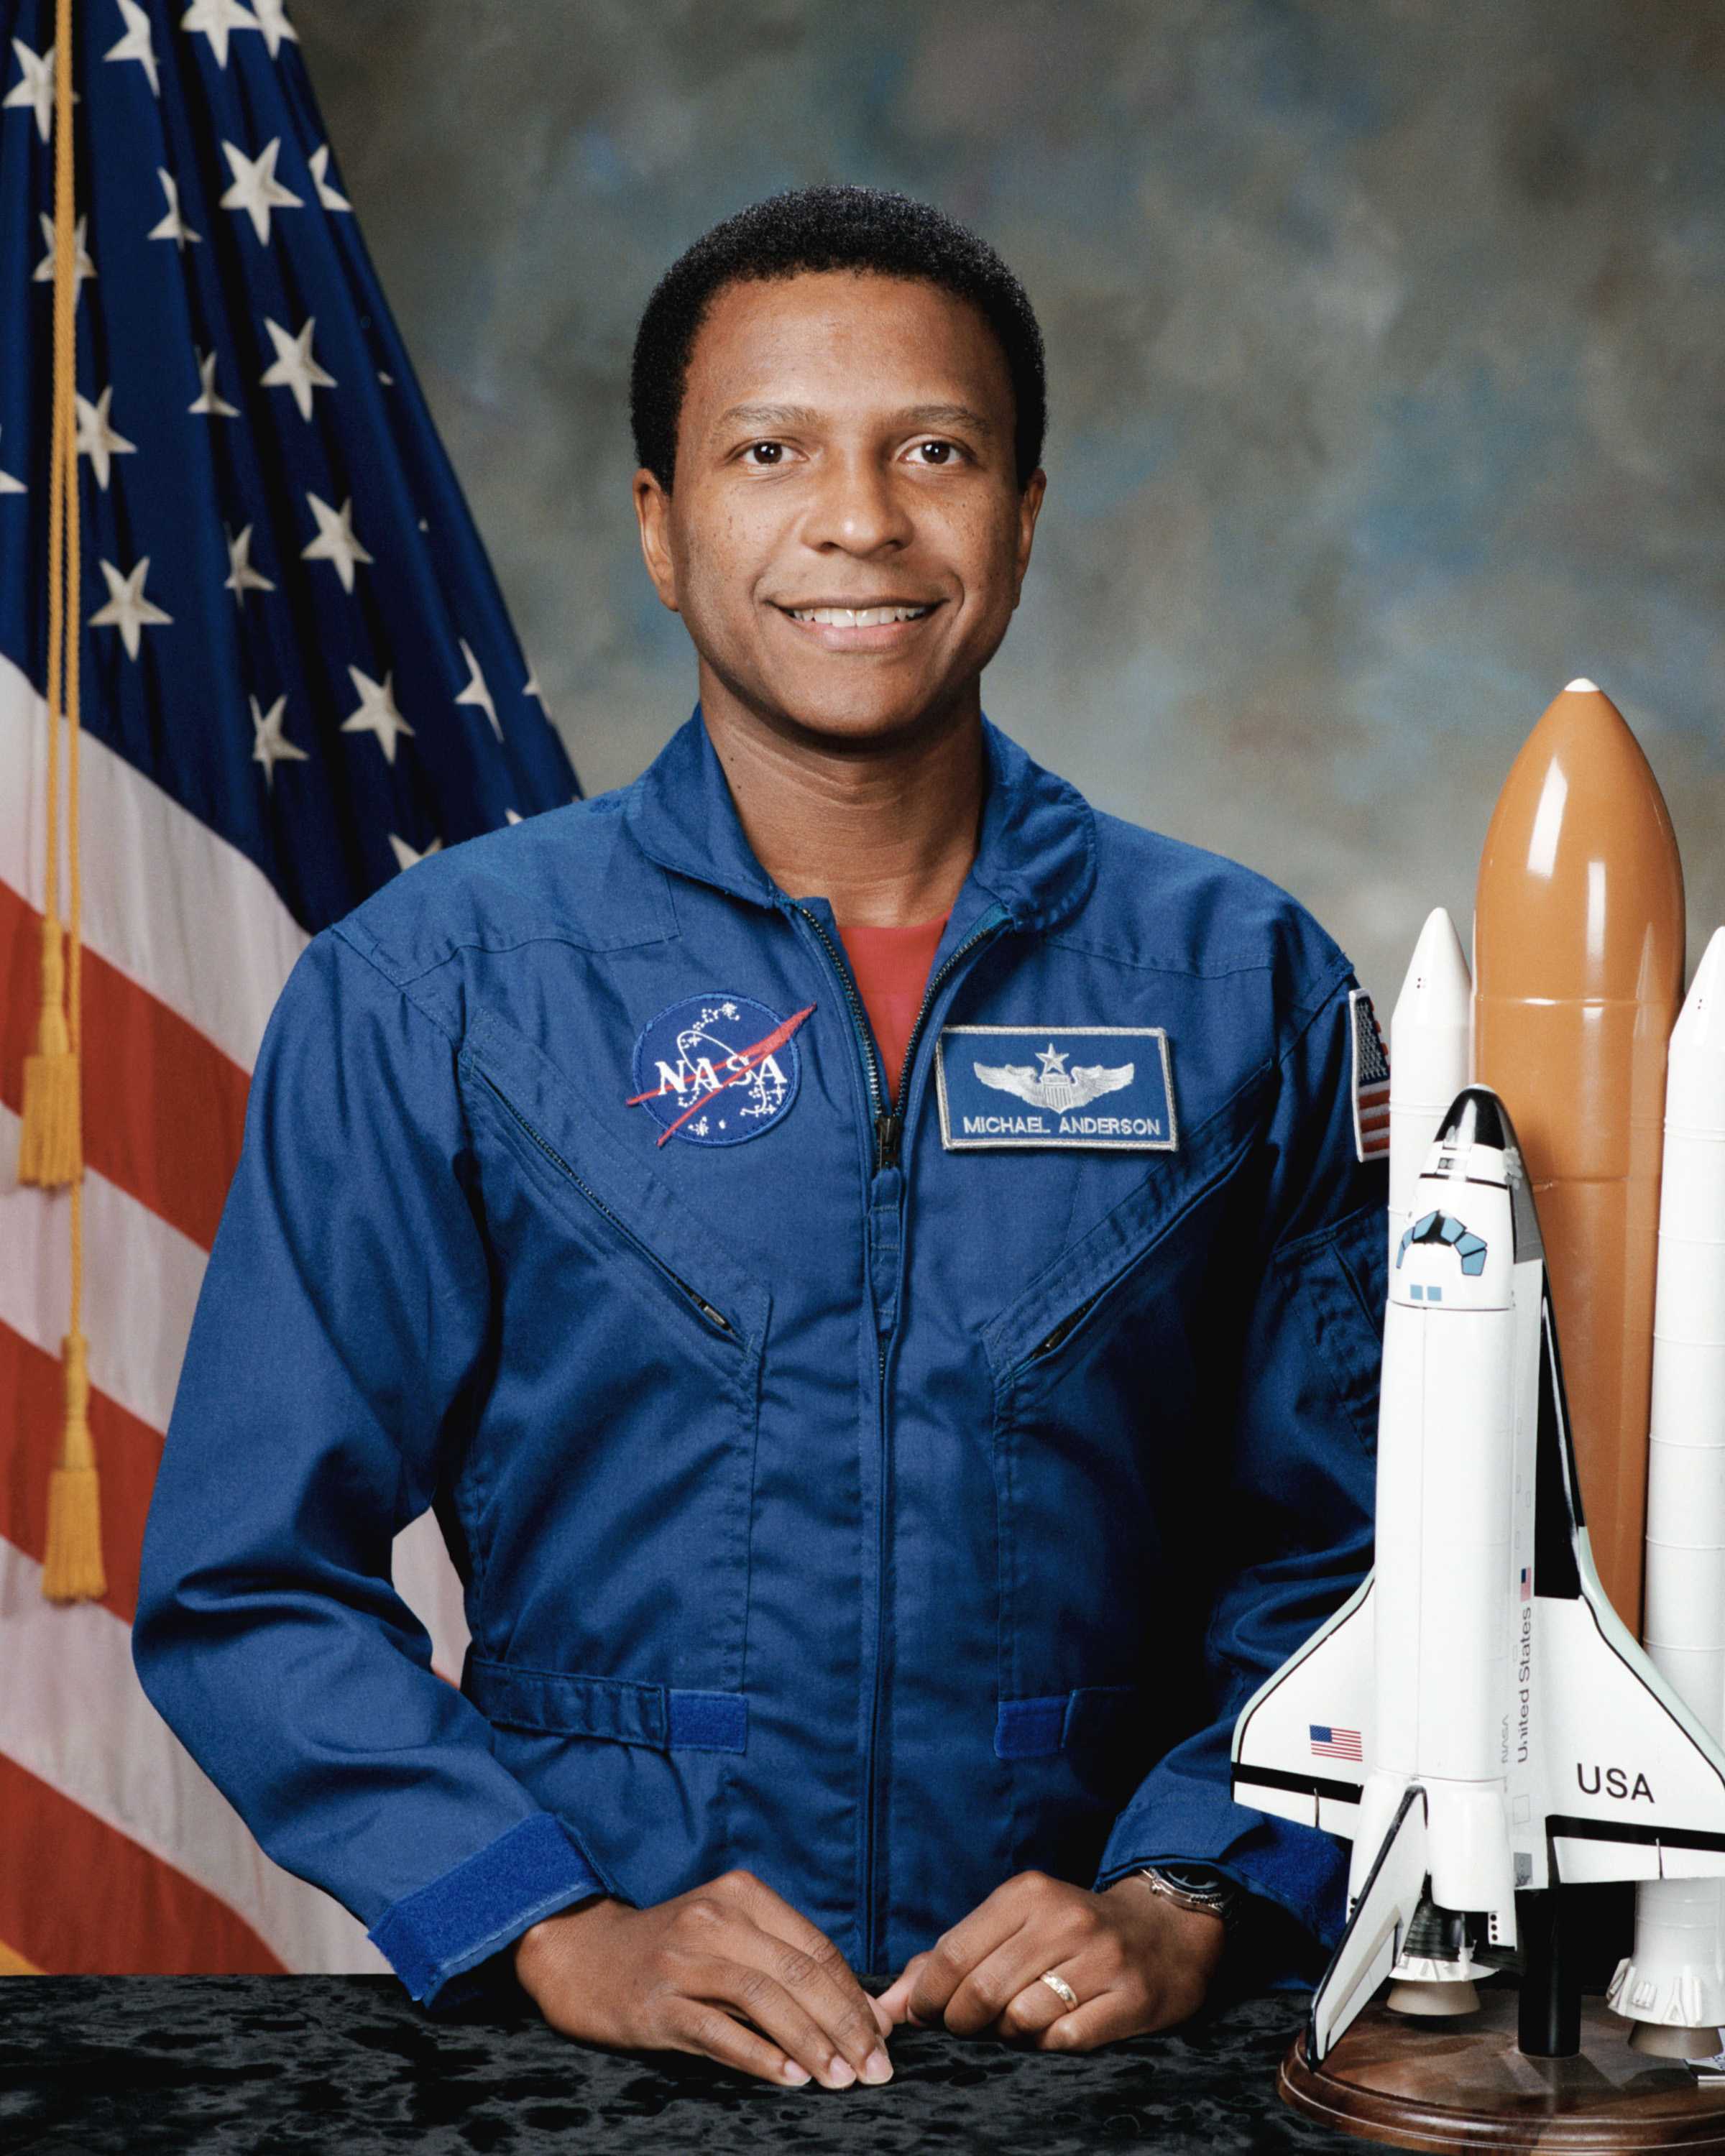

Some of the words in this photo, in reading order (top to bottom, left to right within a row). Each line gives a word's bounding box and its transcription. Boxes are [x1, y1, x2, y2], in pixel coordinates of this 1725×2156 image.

[655, 1054, 788, 1095] NASA
[963, 1116, 1051, 1134] MICHAEL
[1059, 1117, 1162, 1135] ANDERSON
[1518, 1607, 1531, 1682] States
[1517, 1688, 1530, 1763] United
[1577, 1763, 1655, 1803] USA
